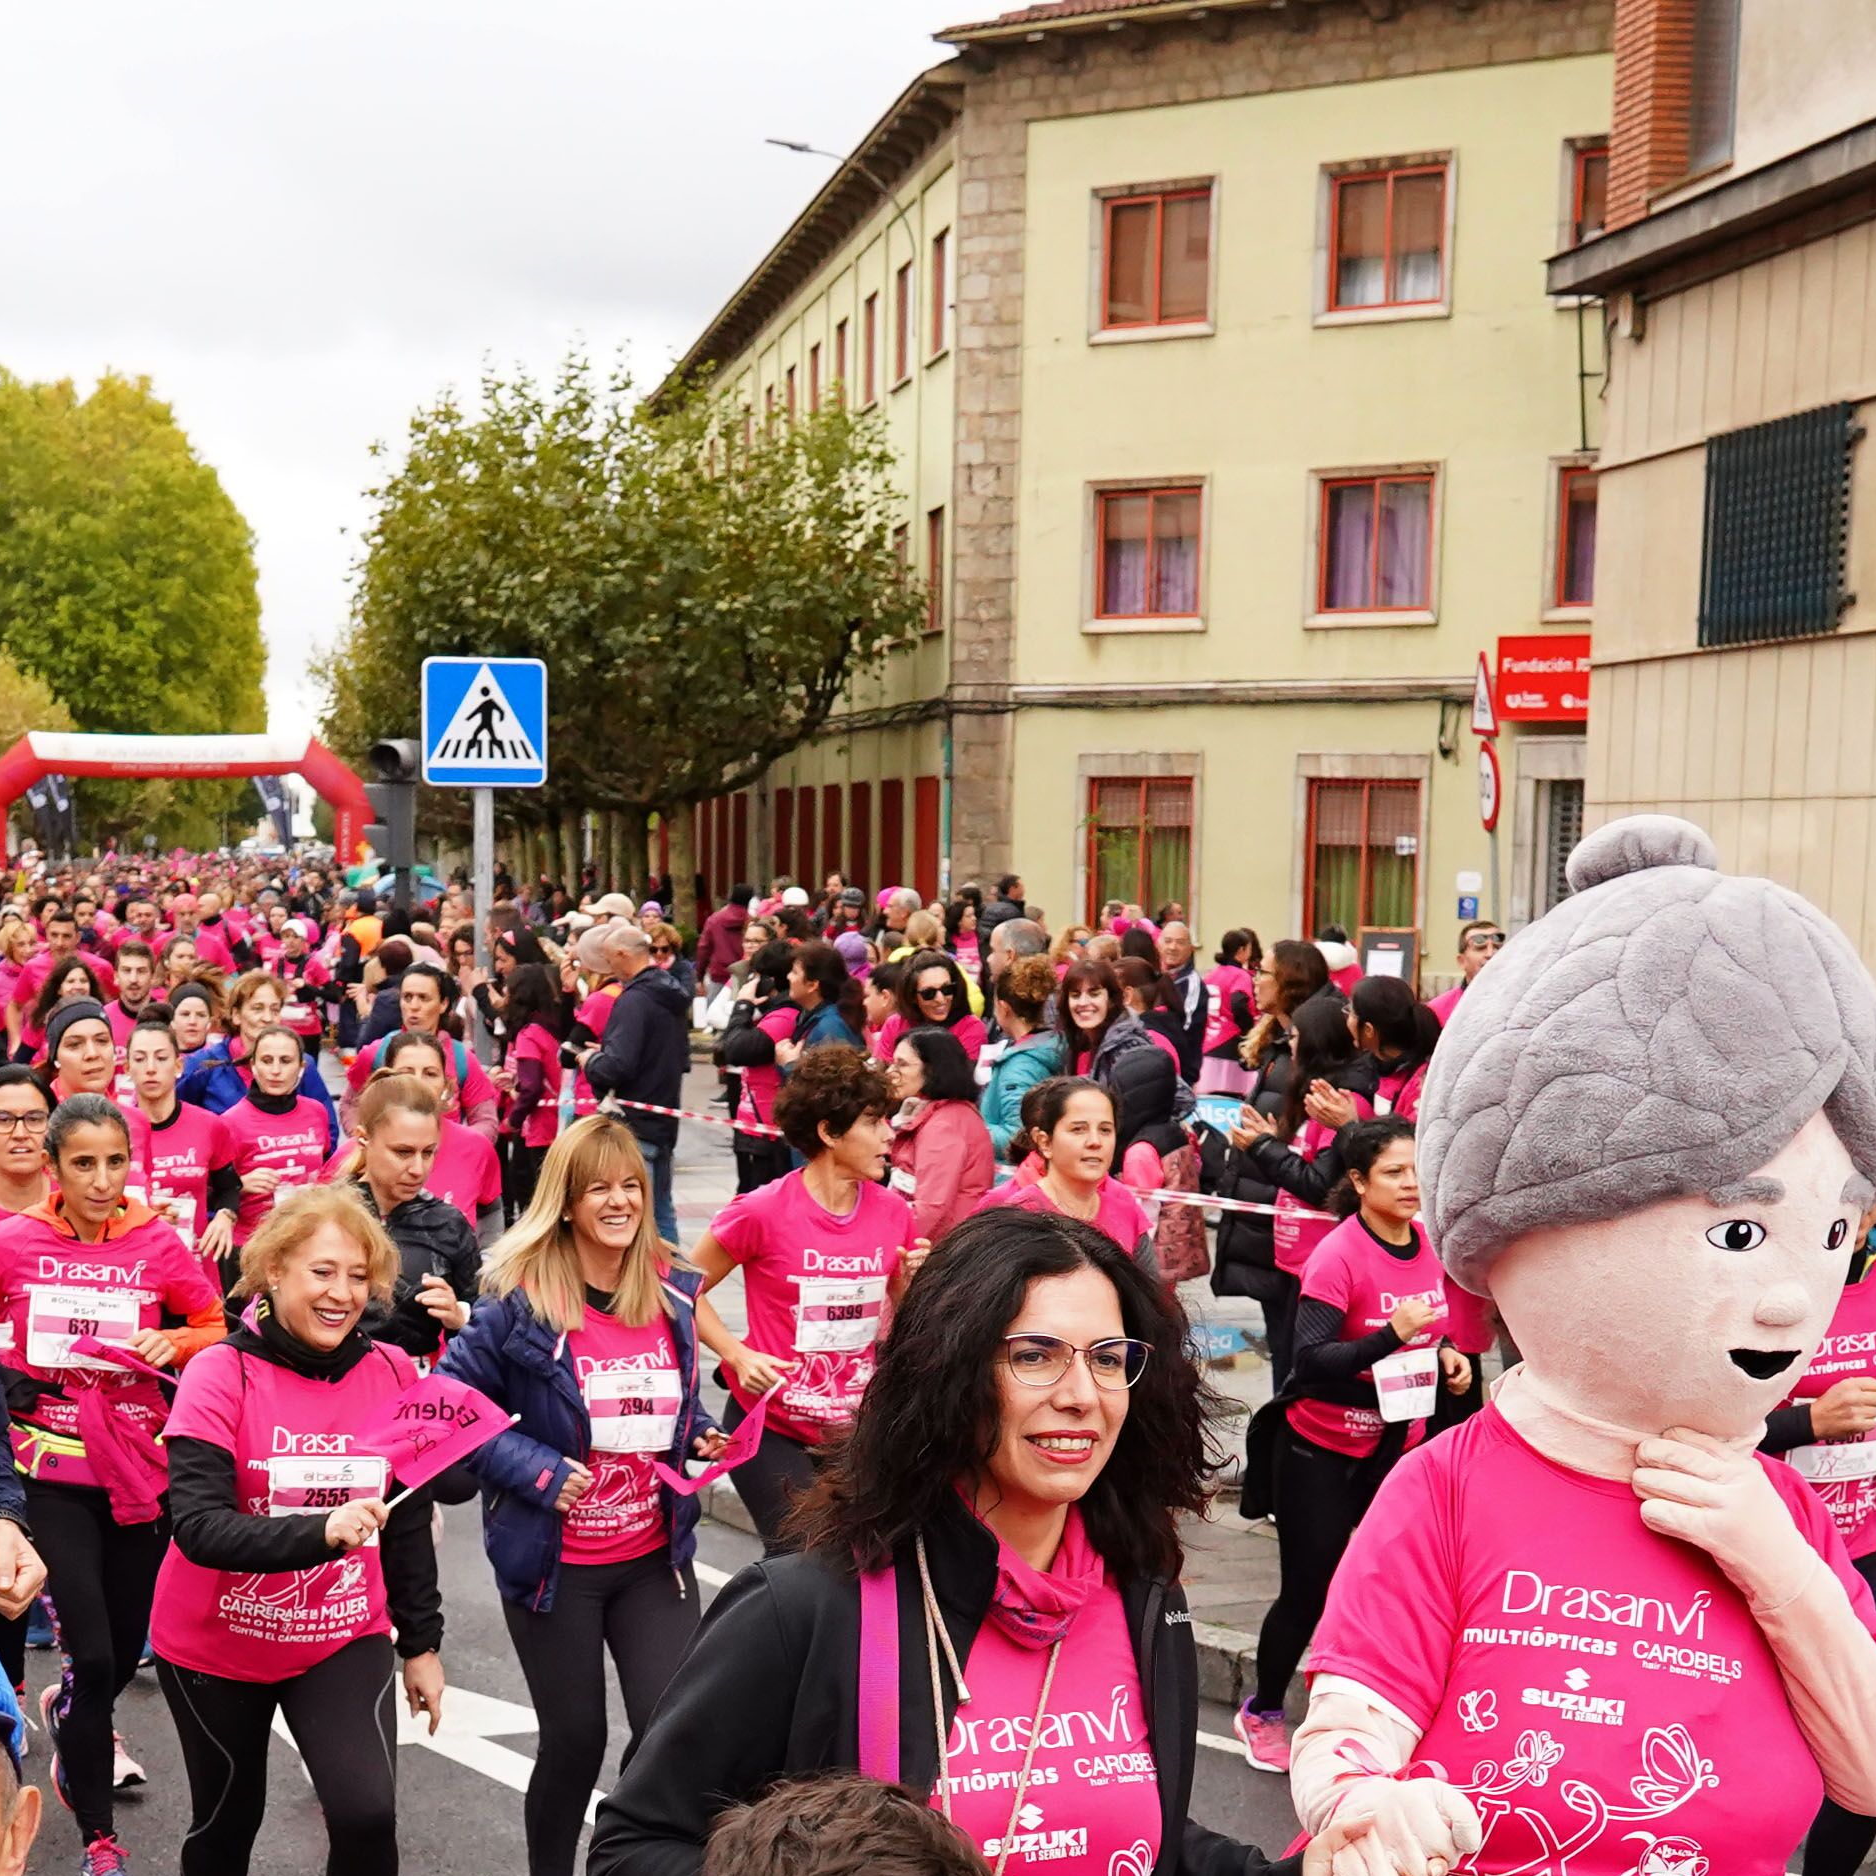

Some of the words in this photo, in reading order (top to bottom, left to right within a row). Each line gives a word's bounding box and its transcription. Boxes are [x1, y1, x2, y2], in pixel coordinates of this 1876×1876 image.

[1502, 656, 1574, 673] Fundación
[827, 1303, 863, 1321] 6399
[68, 1318, 99, 1337] 637
[302, 1487, 350, 1508] 2555
[320, 1595, 368, 1620] MUJER
[1632, 1640, 1743, 1679] CAROBELS
[1522, 1688, 1625, 1717] SUZUKI
[1561, 1709, 1573, 1721] LA
[983, 1828, 1087, 1857] SUZUKI
